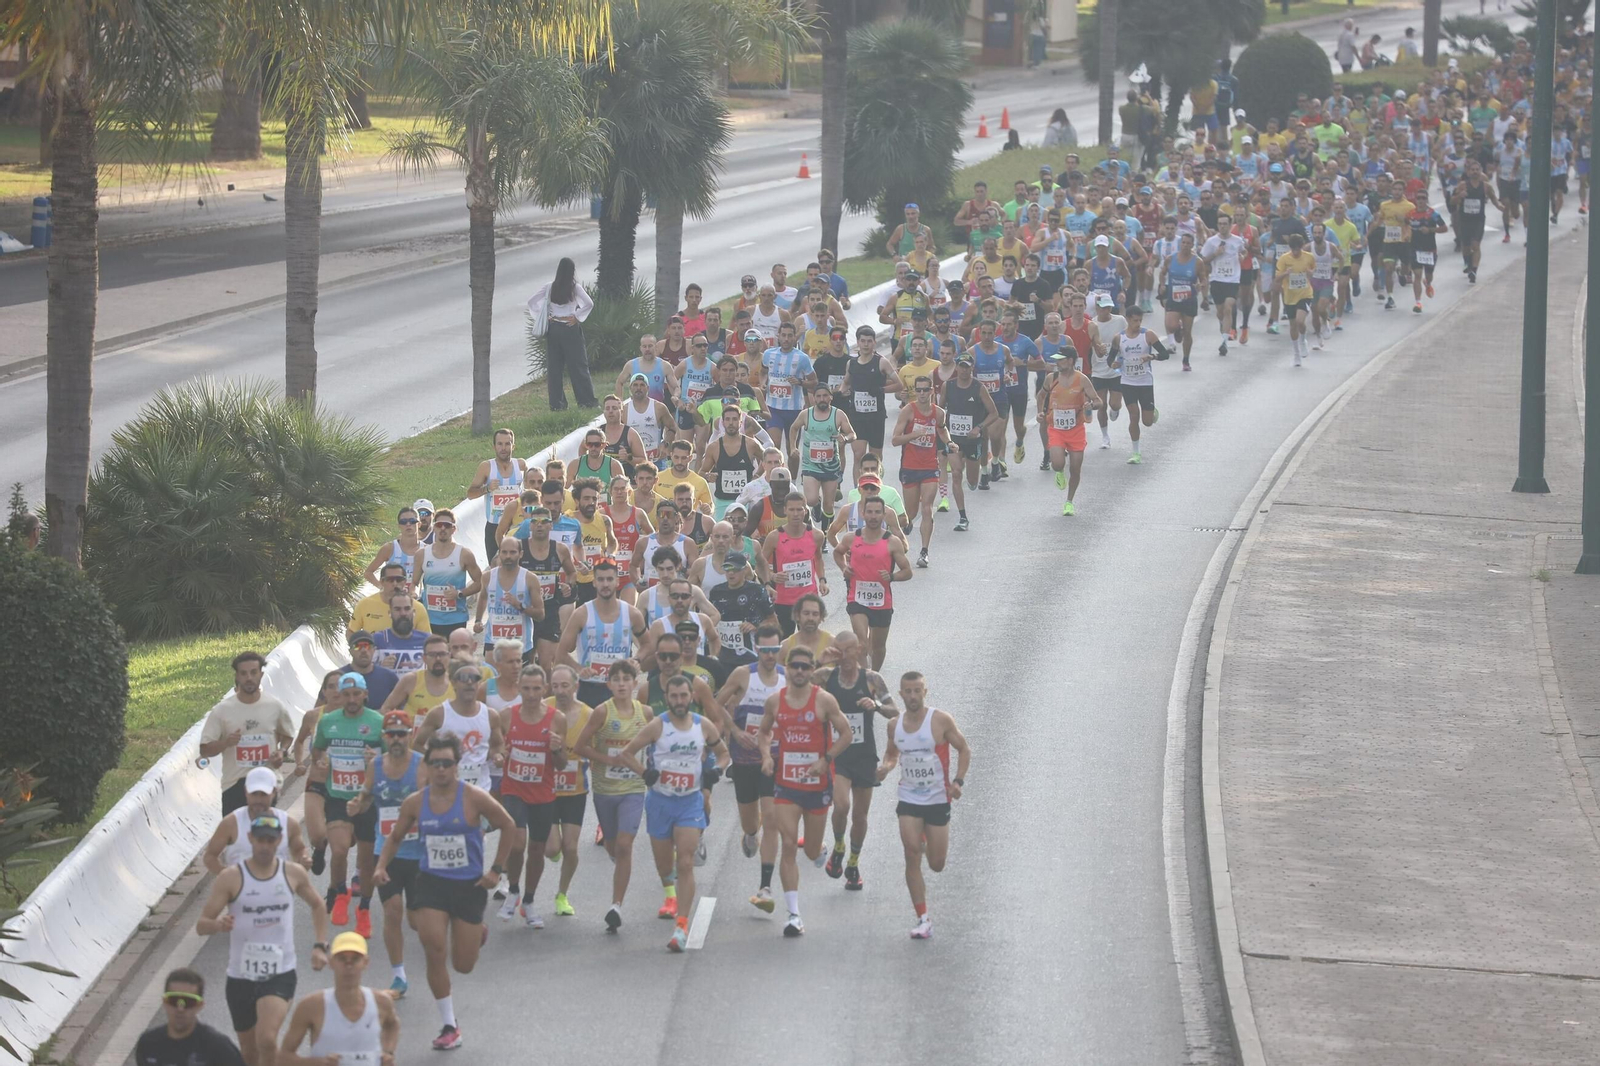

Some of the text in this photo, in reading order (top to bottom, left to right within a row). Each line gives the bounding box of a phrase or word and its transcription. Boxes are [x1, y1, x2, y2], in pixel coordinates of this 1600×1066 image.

[1126, 364, 1144, 372] 7796
[687, 373, 709, 382] nerja
[772, 387, 788, 395] 209
[951, 423, 971, 431] 6293
[1055, 418, 1075, 426] 1813
[816, 451, 827, 459] 89
[724, 480, 746, 489] 7145
[857, 590, 884, 600] 11949
[435, 598, 448, 607] 55
[498, 627, 517, 638] 174
[720, 632, 742, 643] 2046
[331, 738, 364, 747] ATLETISMO
[241, 750, 264, 761] 311
[515, 764, 538, 777] 189
[905, 767, 935, 779] 11884
[337, 774, 359, 786] 138
[666, 774, 689, 788] 213
[431, 848, 465, 861] 7666
[244, 959, 278, 975] 1131
